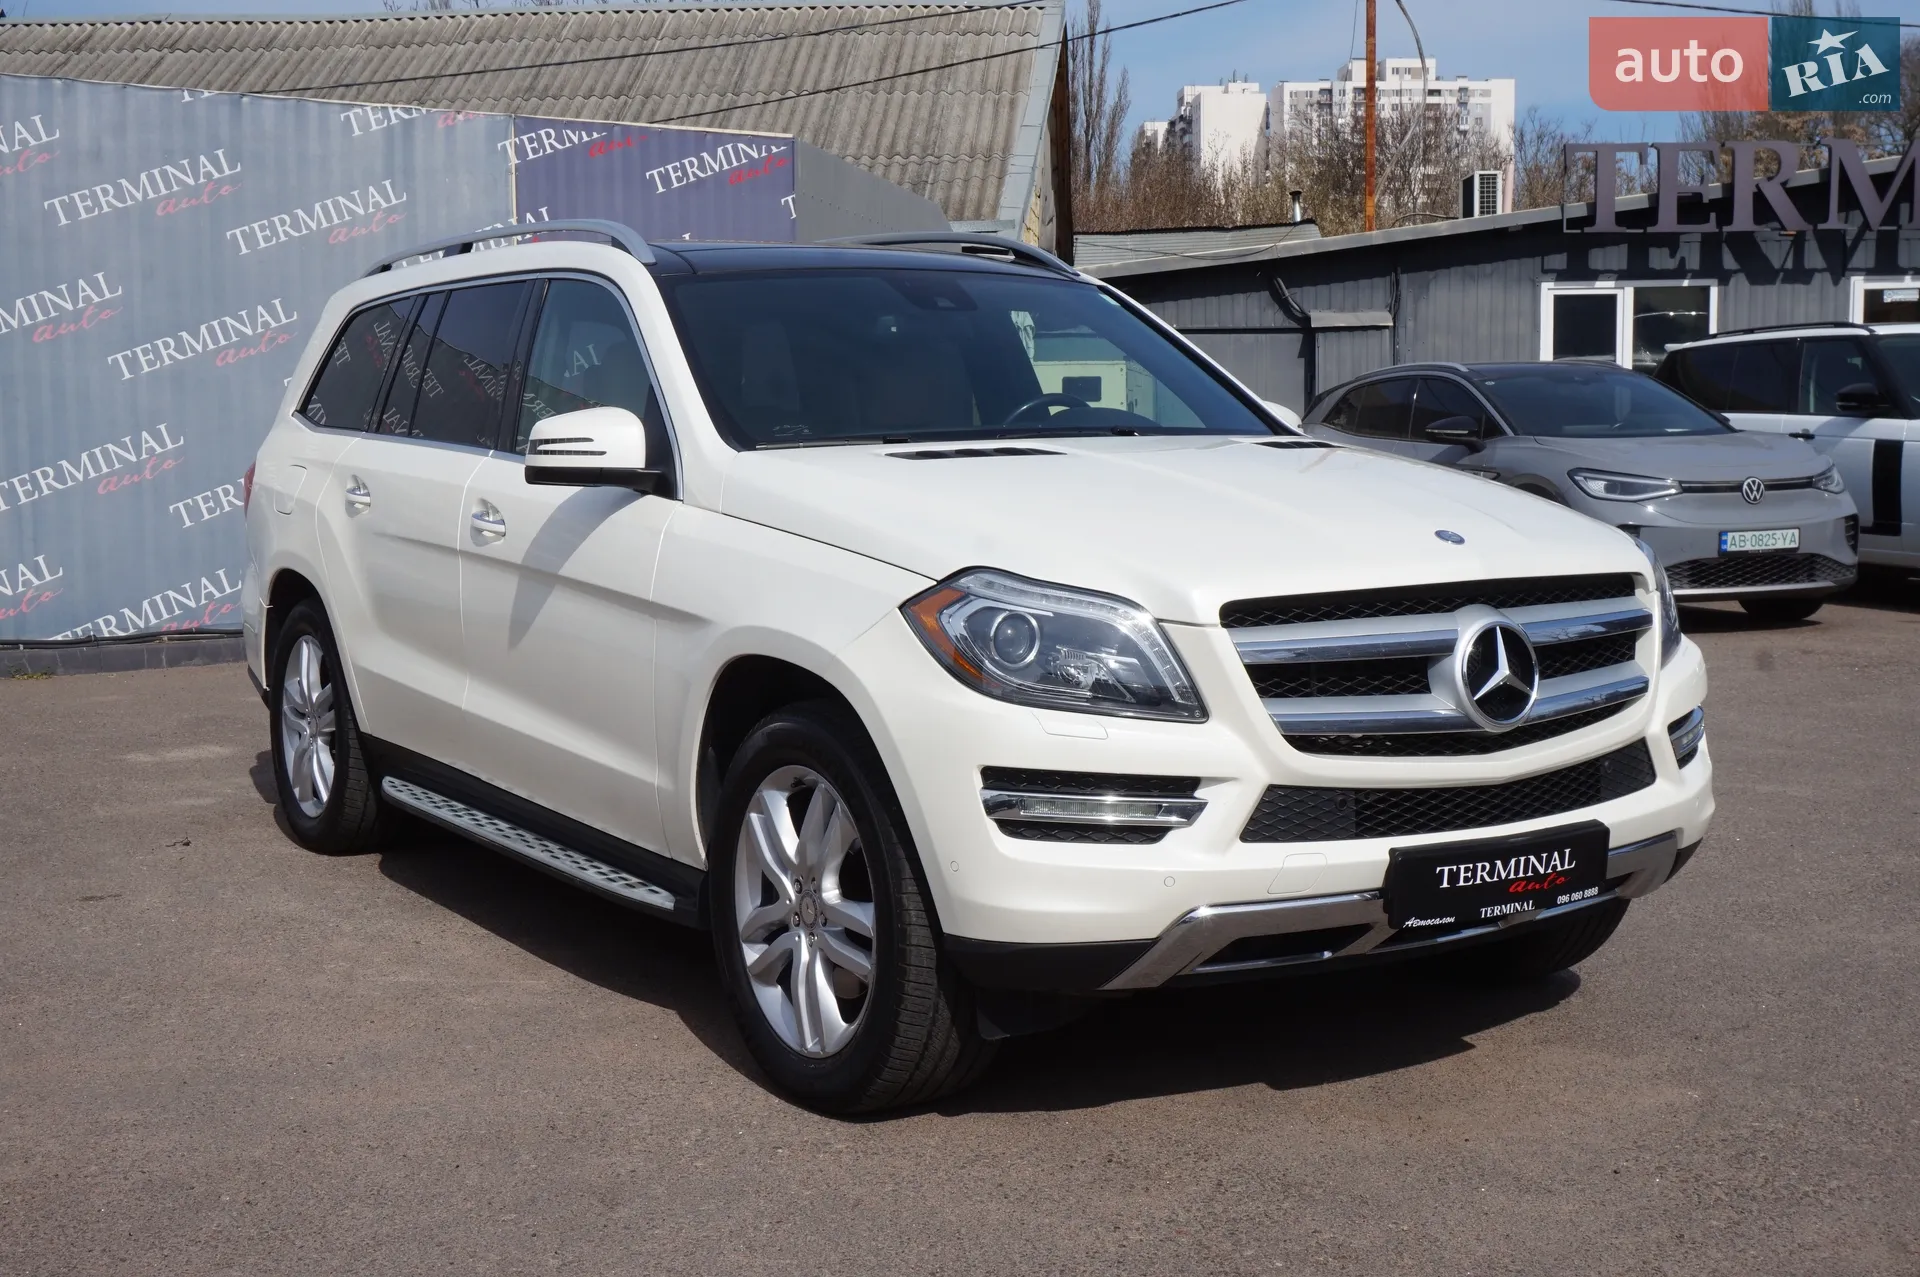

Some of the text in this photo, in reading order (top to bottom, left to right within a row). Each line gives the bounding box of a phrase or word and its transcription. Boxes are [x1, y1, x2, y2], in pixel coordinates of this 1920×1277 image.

[340, 105, 436, 136] TER
[497, 127, 608, 166] TERM
[645, 142, 787, 194] TERMIN
[727, 155, 793, 185] auto
[1563, 138, 1920, 233] TERM
[44, 148, 241, 227] TERMINAL
[156, 180, 242, 216] auto
[226, 179, 407, 255] TERMINAL
[328, 210, 407, 244] auto
[31, 305, 124, 343] auto
[107, 298, 297, 380] TERMINAL
[216, 330, 298, 367] auto
[97, 456, 185, 495] auto
[169, 477, 244, 529] TER
[1435, 848, 1576, 889] TERMINAL
[1508, 872, 1571, 893] auto
[1479, 900, 1536, 919] TERMINAL
[1556, 894, 1570, 905] 096
[1570, 890, 1583, 902] 060
